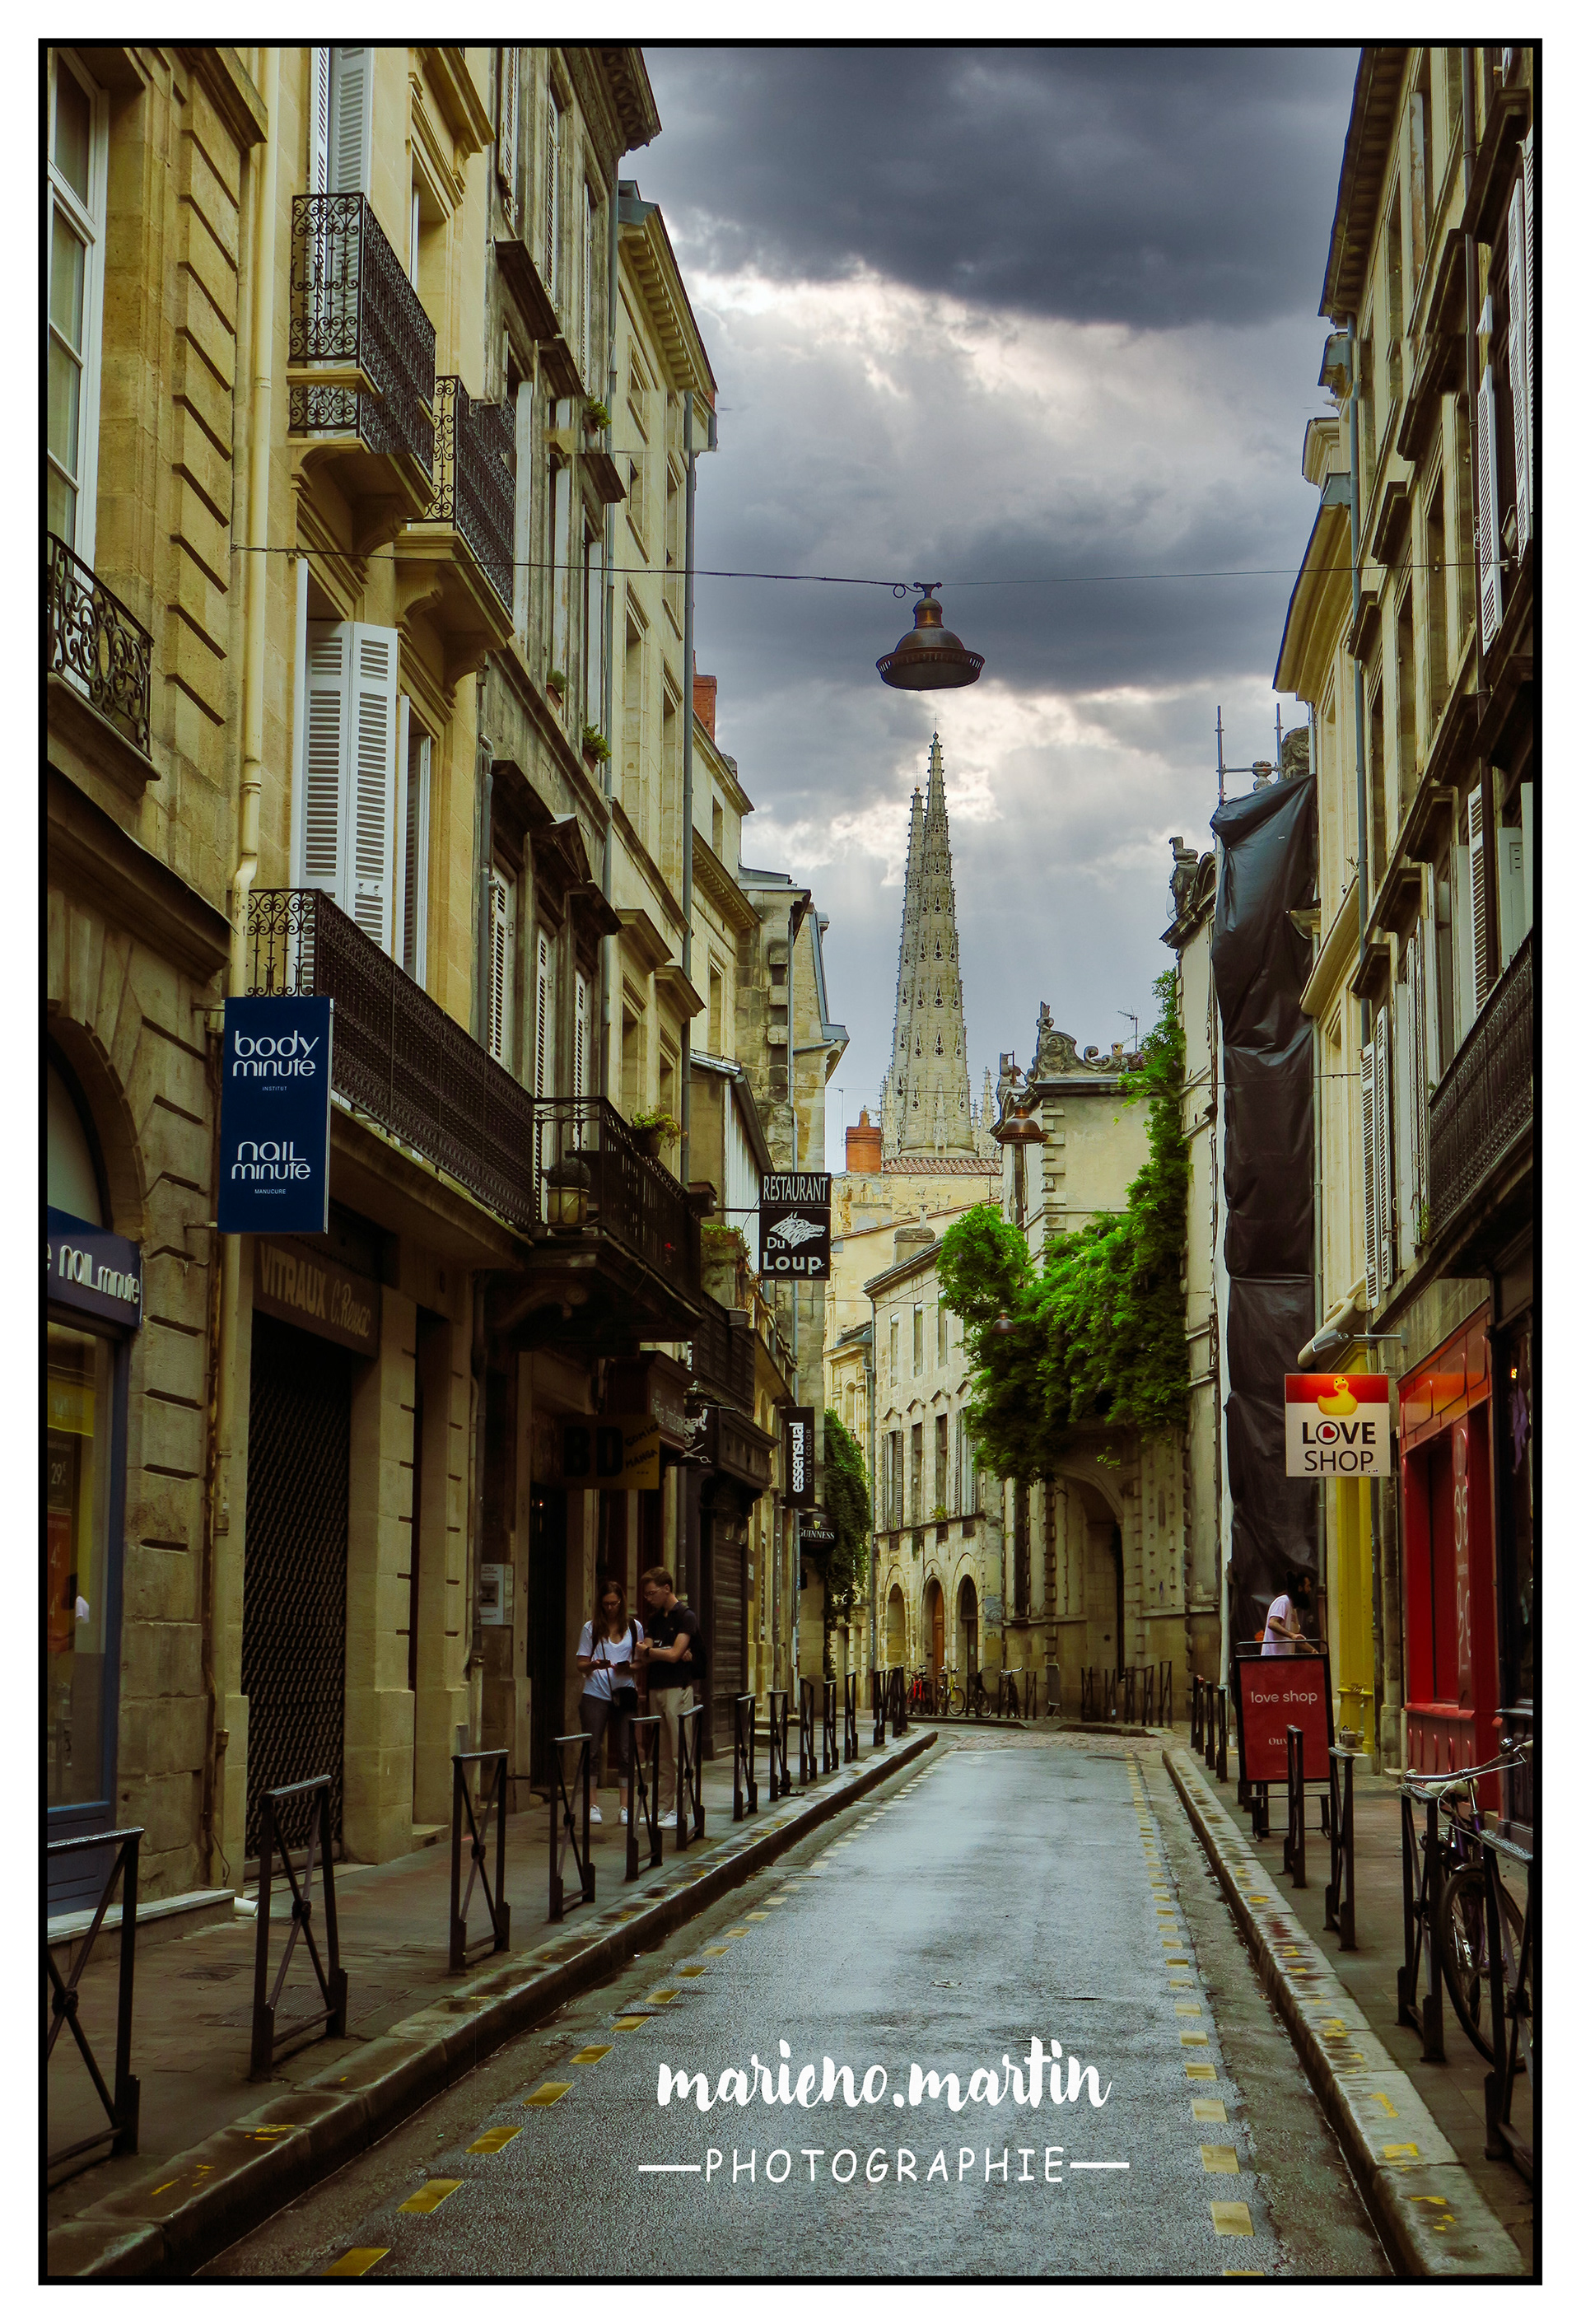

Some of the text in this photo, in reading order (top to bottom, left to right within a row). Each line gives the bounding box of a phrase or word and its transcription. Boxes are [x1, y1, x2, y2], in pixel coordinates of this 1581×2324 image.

[235, 1030, 319, 1058] body
[232, 1058, 316, 1076] minute
[231, 1162, 311, 1179] minute
[763, 1175, 828, 1202] RESTAURANT
[767, 1236, 786, 1249] Du
[763, 1251, 823, 1276] Loup
[259, 1240, 327, 1321] VITRAUX
[1302, 1421, 1376, 1445] LOVE
[563, 1426, 623, 1477] BD
[789, 1422, 804, 1493] essensual
[1304, 1450, 1374, 1472] SHOP
[799, 1527, 835, 1540] GUINNESS
[1251, 1690, 1318, 1705] love shop
